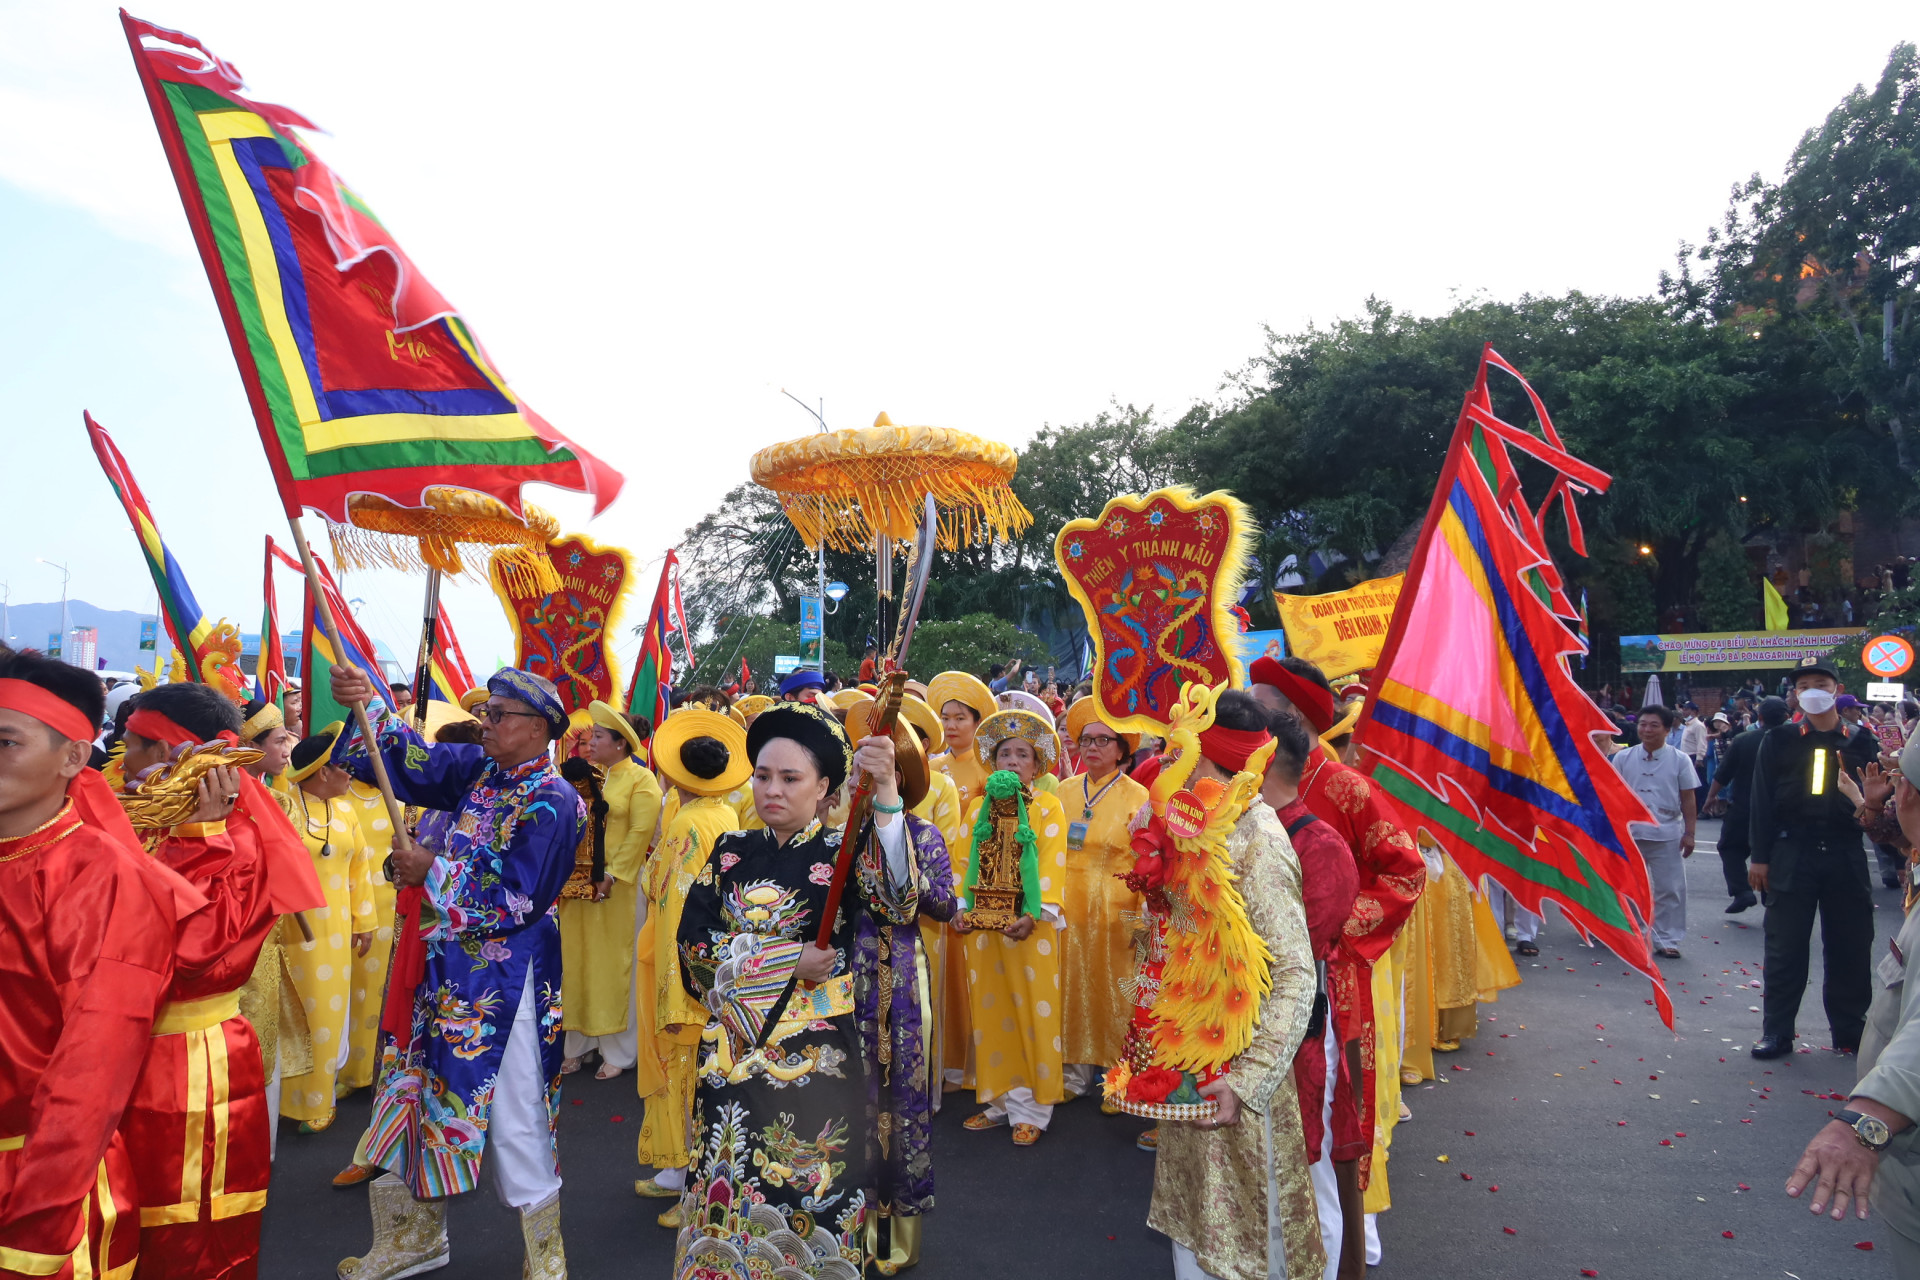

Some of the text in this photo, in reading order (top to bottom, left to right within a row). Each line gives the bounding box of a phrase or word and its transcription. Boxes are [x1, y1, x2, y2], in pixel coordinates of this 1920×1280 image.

[1082, 534, 1214, 588] THIÊN Y THÁNH MẪU
[587, 583, 613, 604] MẪU
[1311, 598, 1336, 619] ĐOÀN
[1332, 598, 1351, 614] KIM
[1333, 614, 1359, 641] DIÊN
[1353, 609, 1385, 637] KHÁNH
[1657, 640, 1683, 651] CHÀO
[1683, 637, 1709, 650] MỪNG
[1710, 639, 1726, 651] ĐẠI
[1727, 634, 1746, 649] BIỂU
[1745, 636, 1759, 648] VÀ
[1760, 634, 1791, 648] KHÁCH
[1792, 633, 1818, 647] HÀNH
[1679, 650, 1688, 664] LỄ
[1689, 651, 1704, 665] HỘI
[1705, 648, 1727, 663] THÁP
[1728, 650, 1739, 662] BÀ
[1741, 650, 1784, 662] PONAGAR
[1784, 650, 1803, 660] NHA
[1172, 798, 1204, 821] THÀNH KÍNH
